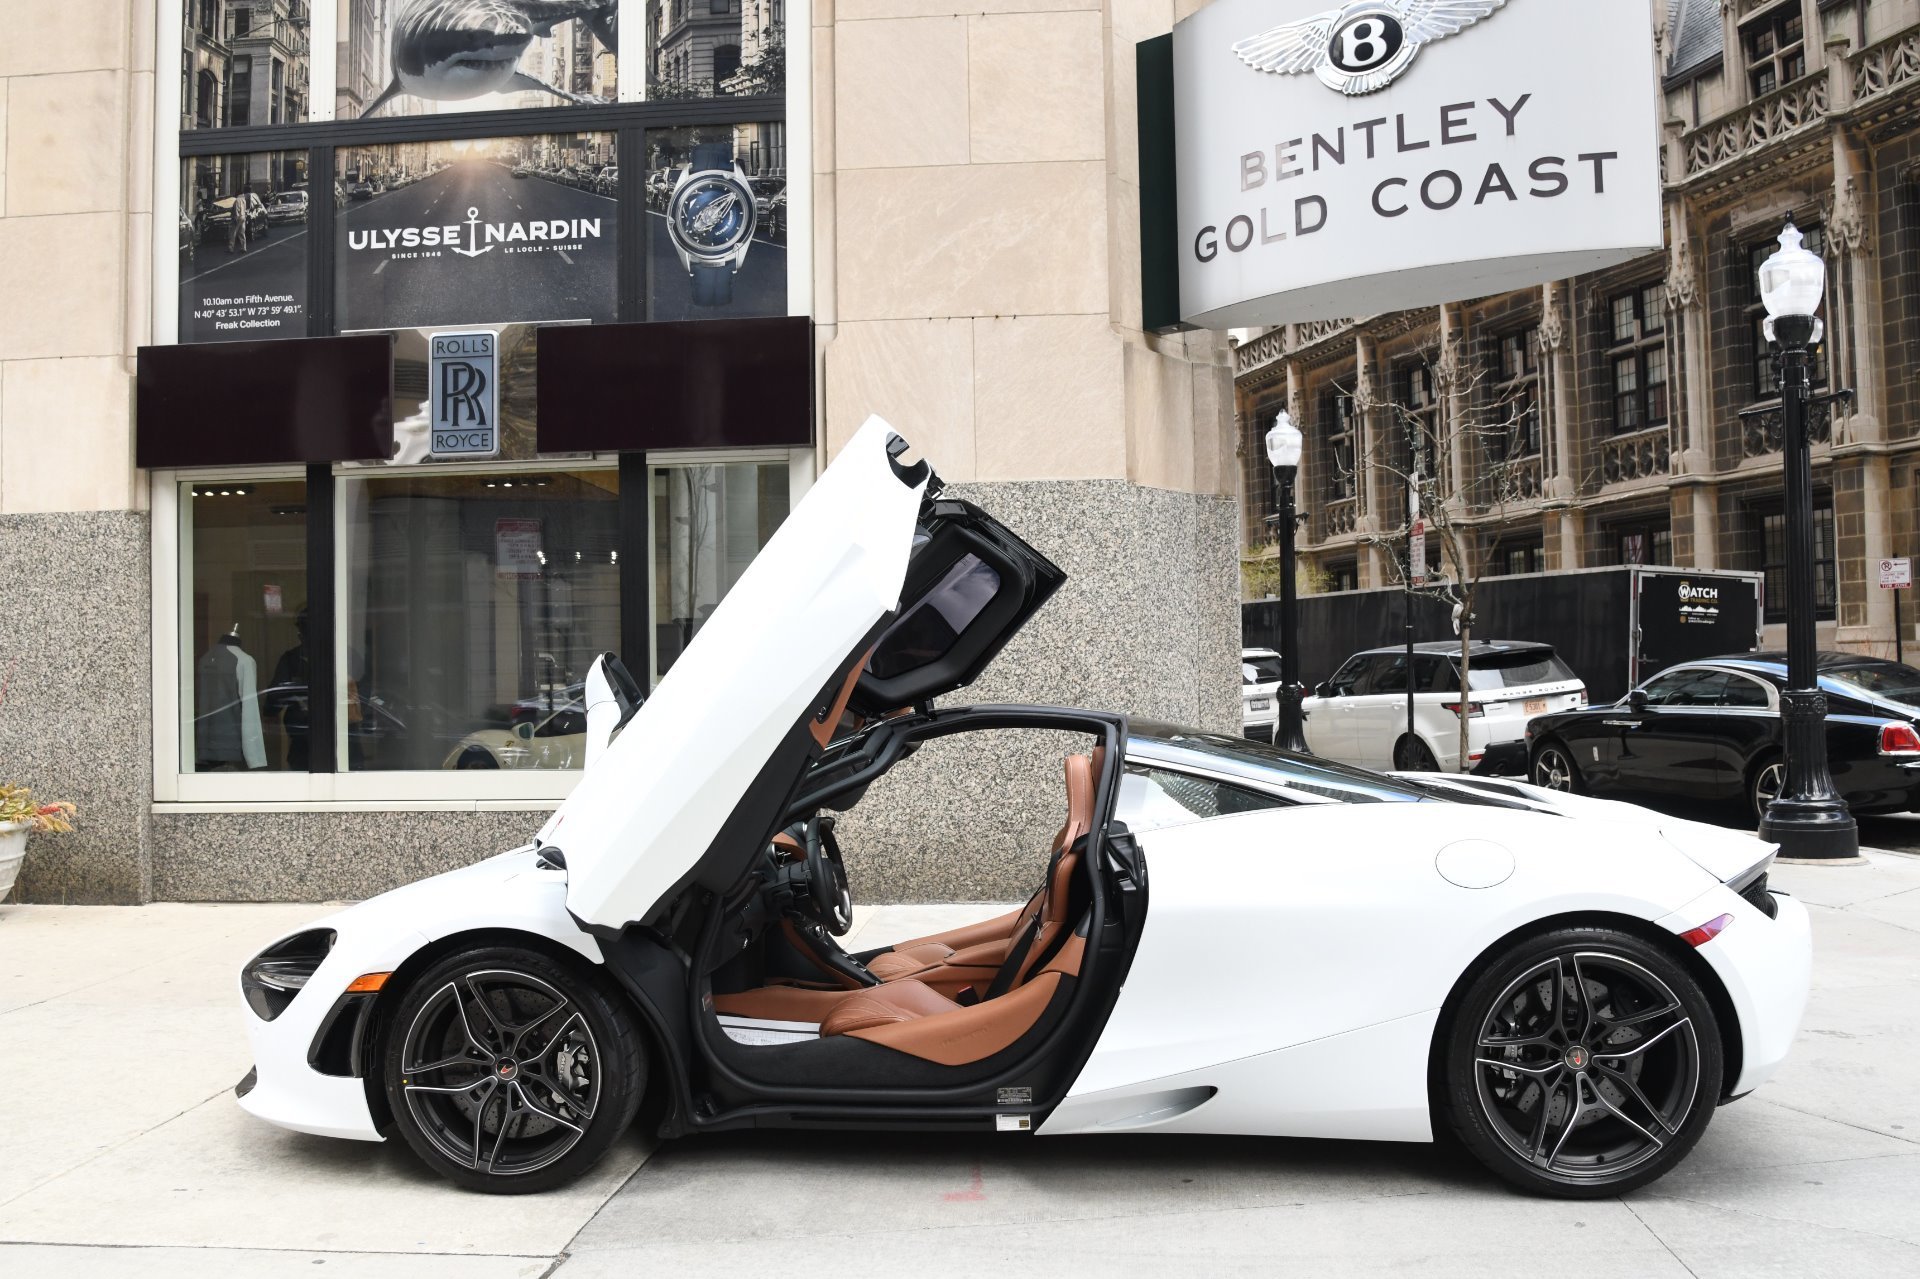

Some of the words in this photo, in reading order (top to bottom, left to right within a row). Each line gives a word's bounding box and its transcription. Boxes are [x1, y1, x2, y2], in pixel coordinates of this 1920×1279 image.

[1340, 18, 1388, 67] B
[1240, 93, 1533, 193] BENTLEY
[1194, 194, 1328, 263] GOLD
[1371, 151, 1618, 218] COAST
[348, 225, 461, 250] ULYSSE
[485, 218, 601, 243] NARDIN
[391, 252, 418, 260] SINCE
[202, 297, 232, 306] 10.10am
[233, 297, 244, 305] on
[245, 295, 263, 304] Fifth
[264, 294, 295, 303] Avenue.
[194, 310, 201, 319] N
[247, 307, 256, 316] W
[215, 321, 239, 330] Freak
[239, 318, 281, 329] Collection
[436, 338, 489, 354] ROLLS
[436, 433, 489, 449] ROYCE
[1679, 585, 1718, 599] WATCH
